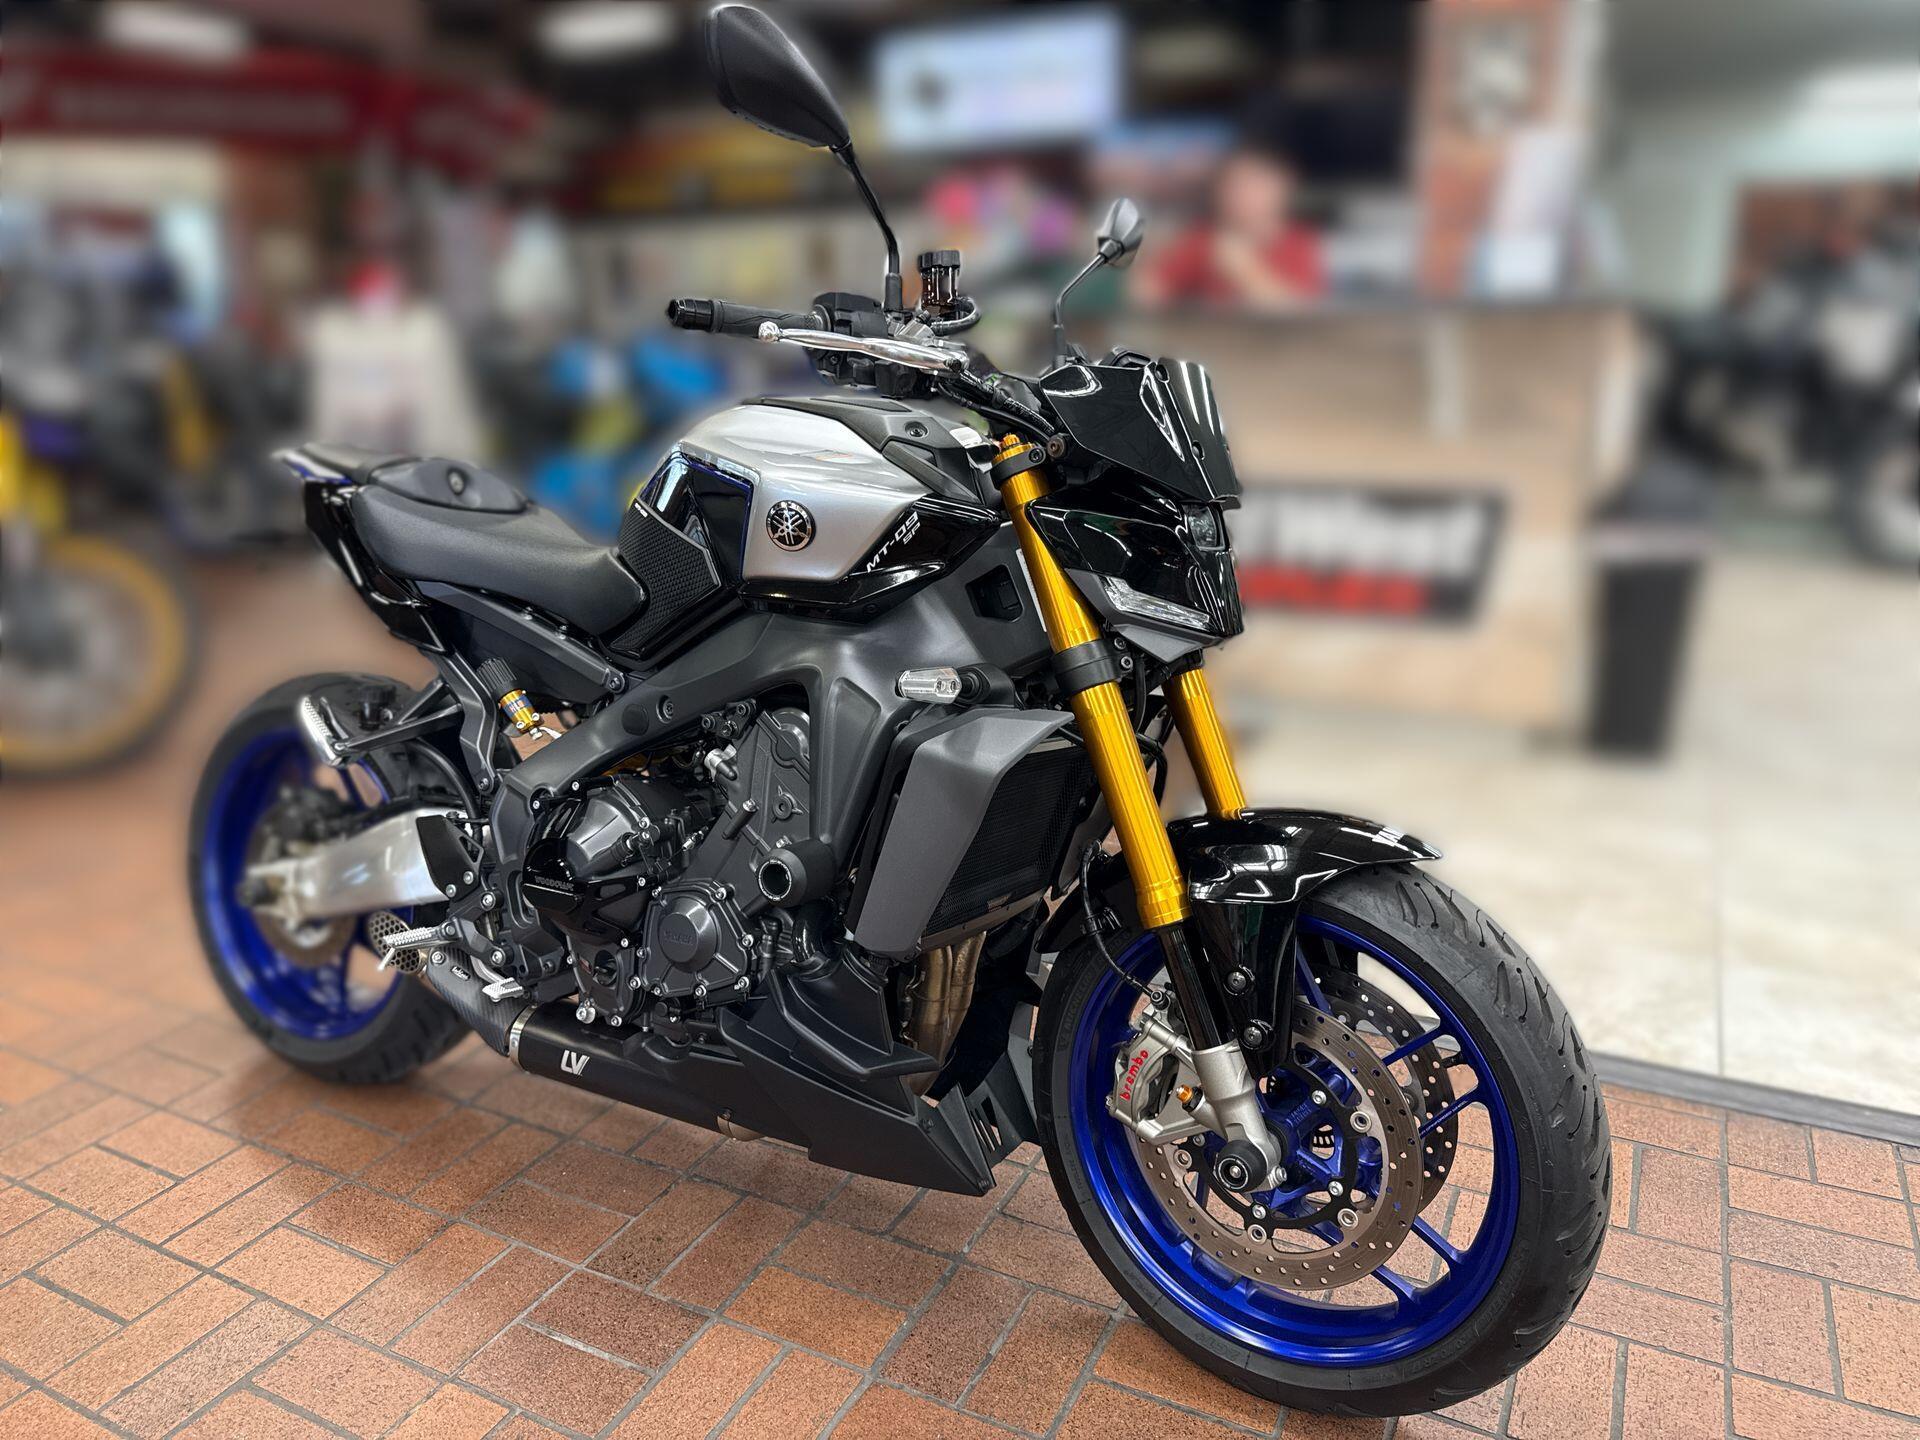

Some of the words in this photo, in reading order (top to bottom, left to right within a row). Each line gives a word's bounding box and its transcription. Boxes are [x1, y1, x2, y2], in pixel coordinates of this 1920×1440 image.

[866, 510, 919, 573] MT-09
[902, 521, 921, 545] SP
[561, 1049, 590, 1076] LV
[1119, 1049, 1149, 1102] brembo
